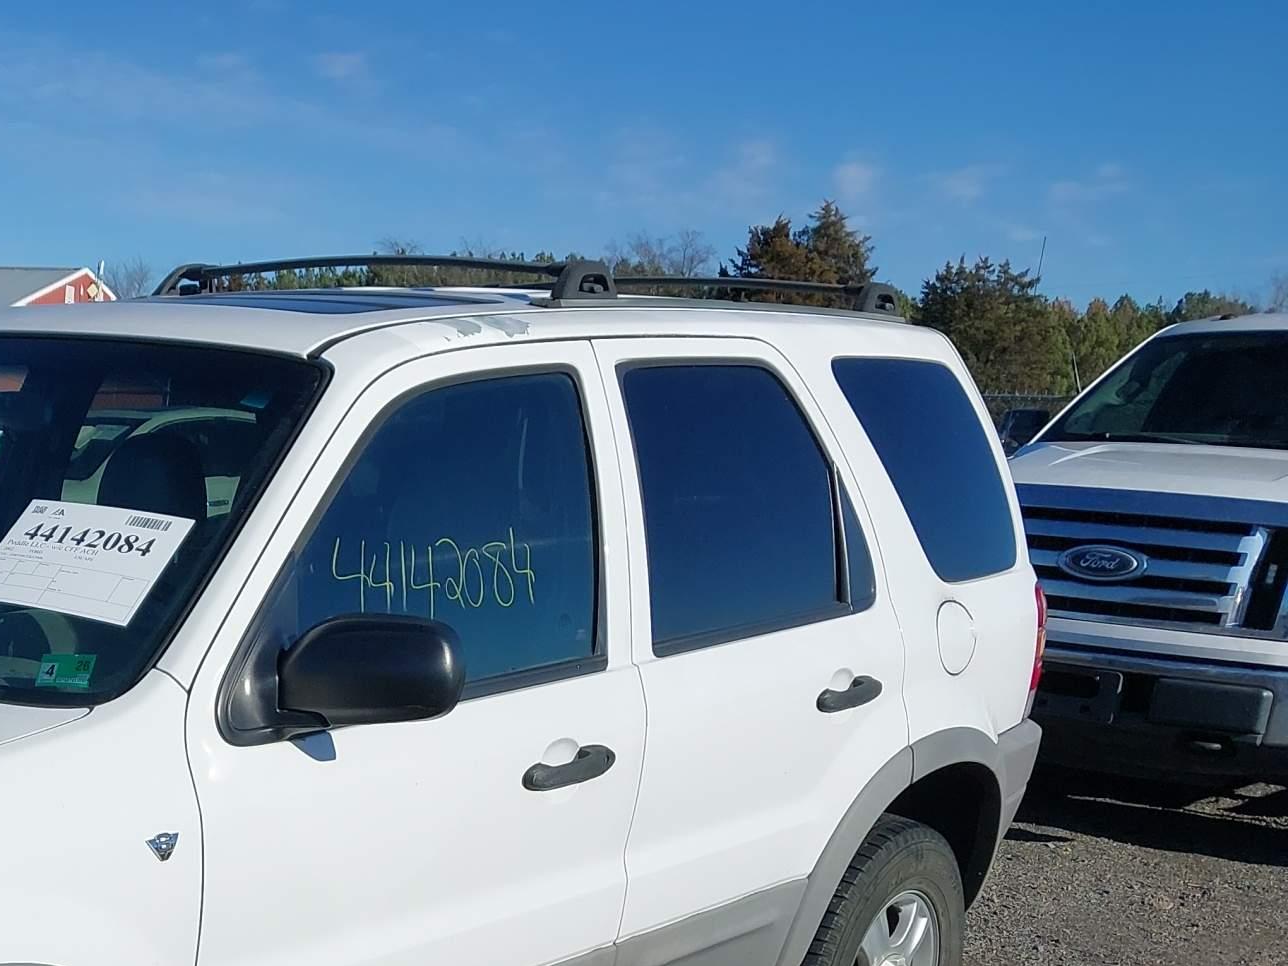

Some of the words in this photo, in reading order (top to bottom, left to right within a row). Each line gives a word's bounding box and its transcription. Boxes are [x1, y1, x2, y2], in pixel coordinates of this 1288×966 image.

[24, 523, 157, 557] 44142084
[332, 527, 536, 620] 44142084
[1079, 551, 1121, 570] Ford
[45, 664, 56, 676] 4
